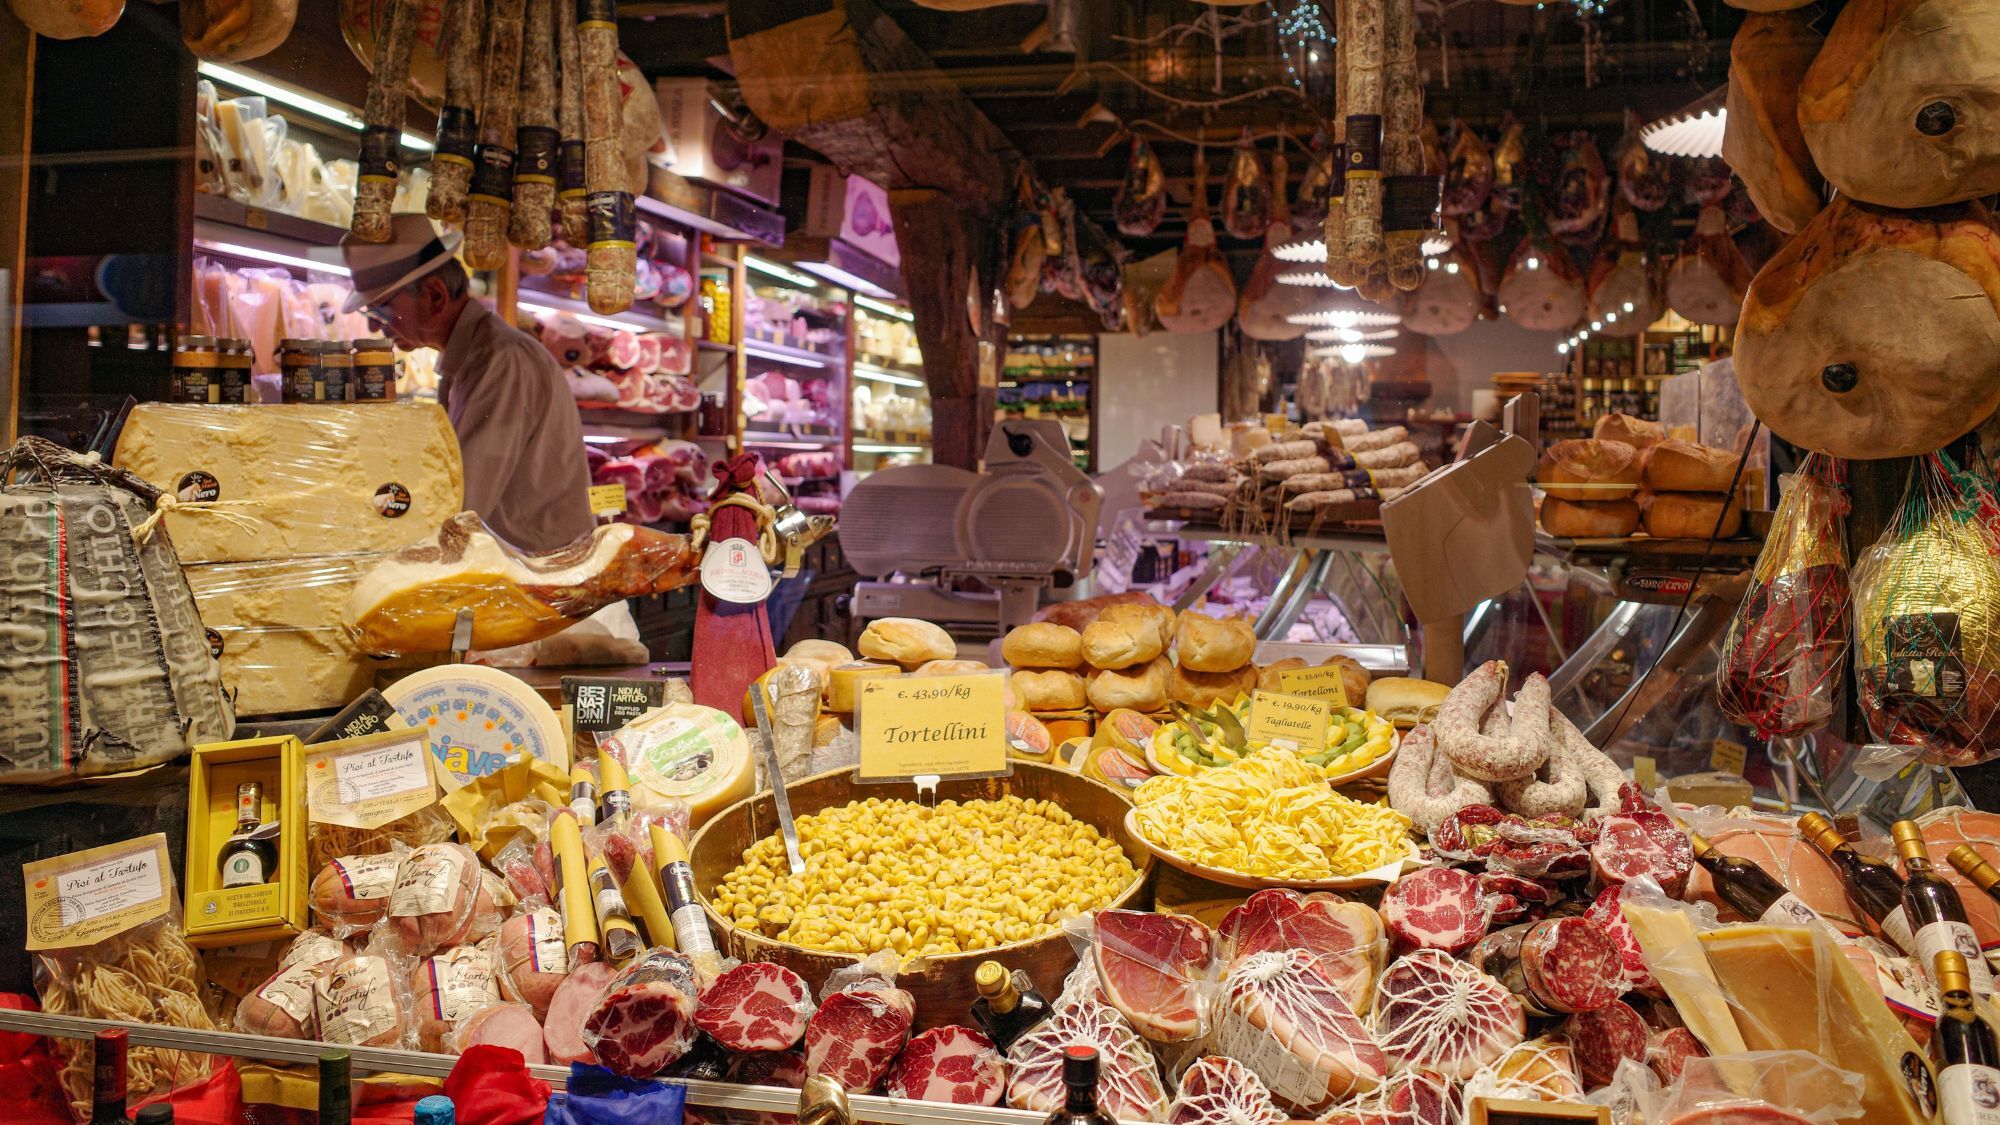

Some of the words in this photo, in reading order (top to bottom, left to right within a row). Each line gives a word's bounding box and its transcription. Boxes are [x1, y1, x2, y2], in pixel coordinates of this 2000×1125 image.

[578, 685, 605, 698] BER
[912, 684, 971, 700] 43,90/kg
[576, 697, 605, 709] NAR
[611, 694, 648, 704] TARTUFO
[576, 708, 604, 720] DINI
[1283, 702, 1322, 715] 19,90/kg
[1264, 716, 1312, 730] Tagliatelle
[883, 721, 988, 744] Tortellini
[343, 763, 364, 774] Pici
[367, 757, 376, 767] al
[379, 750, 414, 765] Tartufo
[66, 876, 91, 891] Pici
[95, 873, 105, 883] al
[108, 860, 148, 880] Tartufo
[325, 991, 339, 1013] al
[339, 976, 377, 1011] tartufo
